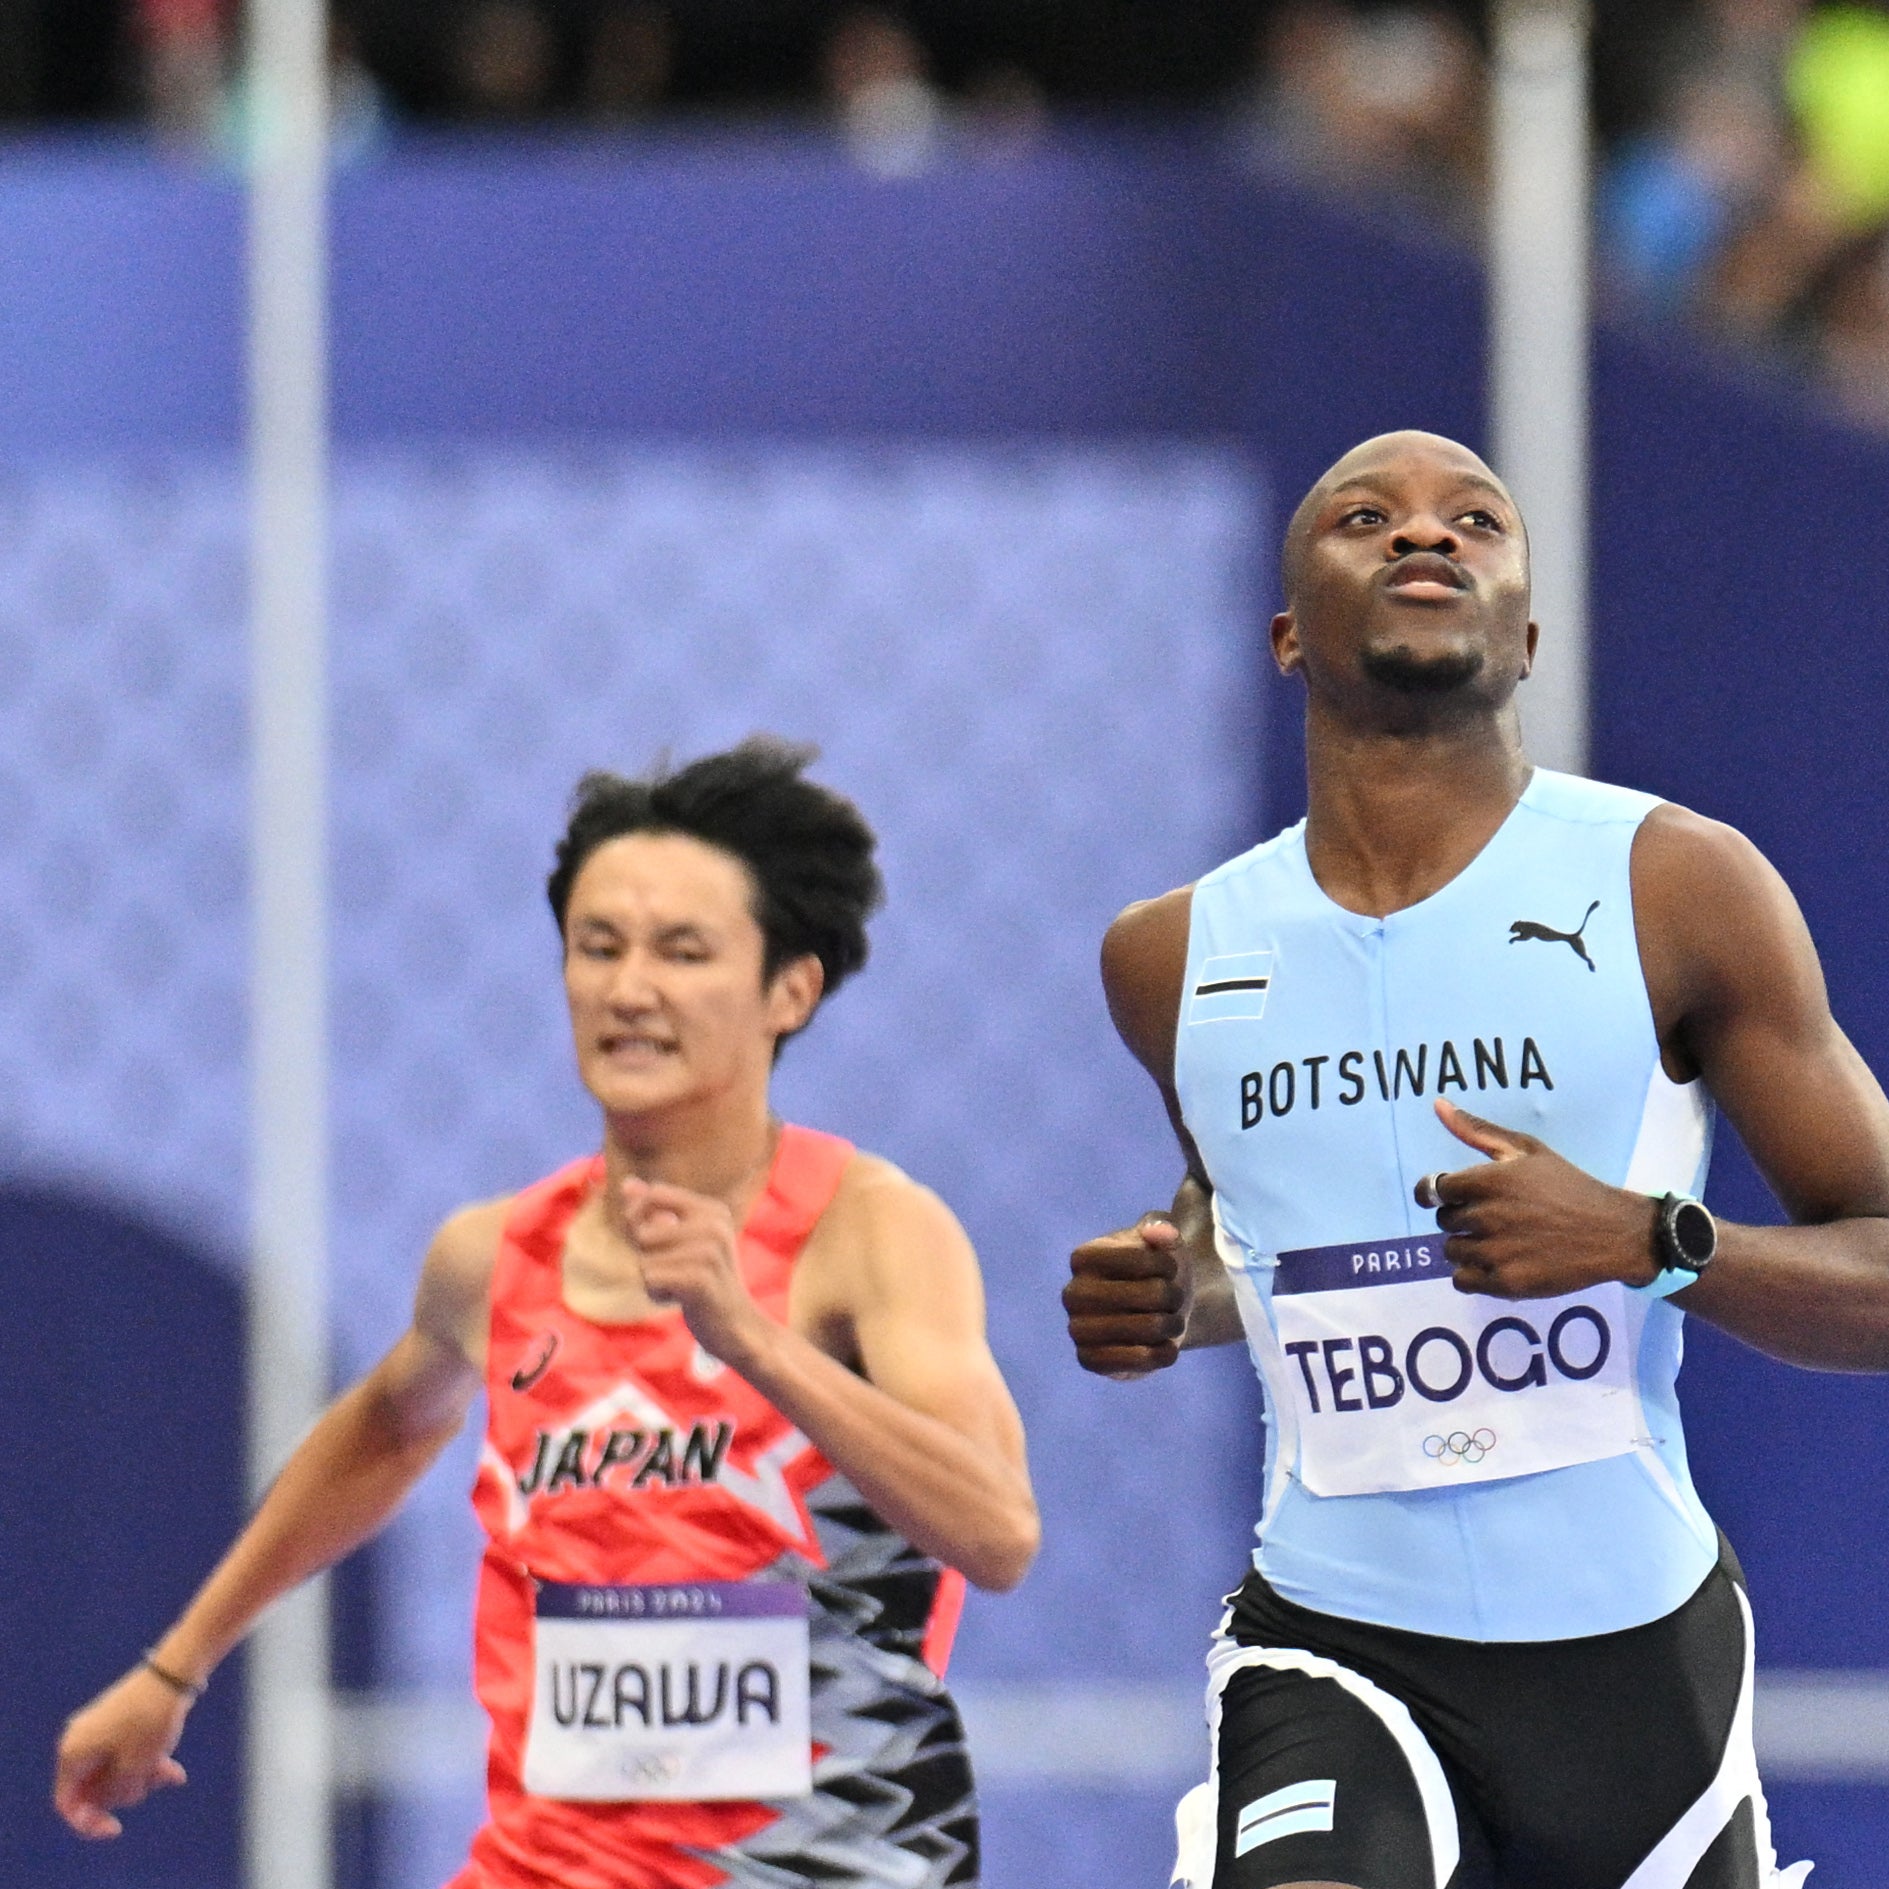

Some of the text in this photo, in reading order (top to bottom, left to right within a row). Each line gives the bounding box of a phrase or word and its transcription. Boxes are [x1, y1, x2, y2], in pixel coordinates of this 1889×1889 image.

[1240, 1036, 1554, 1131] BOTSWANA
[1352, 1246, 1432, 1275] PARIS
[1285, 1305, 1612, 1415] TEBOGO
[516, 1419, 733, 1497] JAPAN
[551, 1660, 782, 1729] UZAWA
